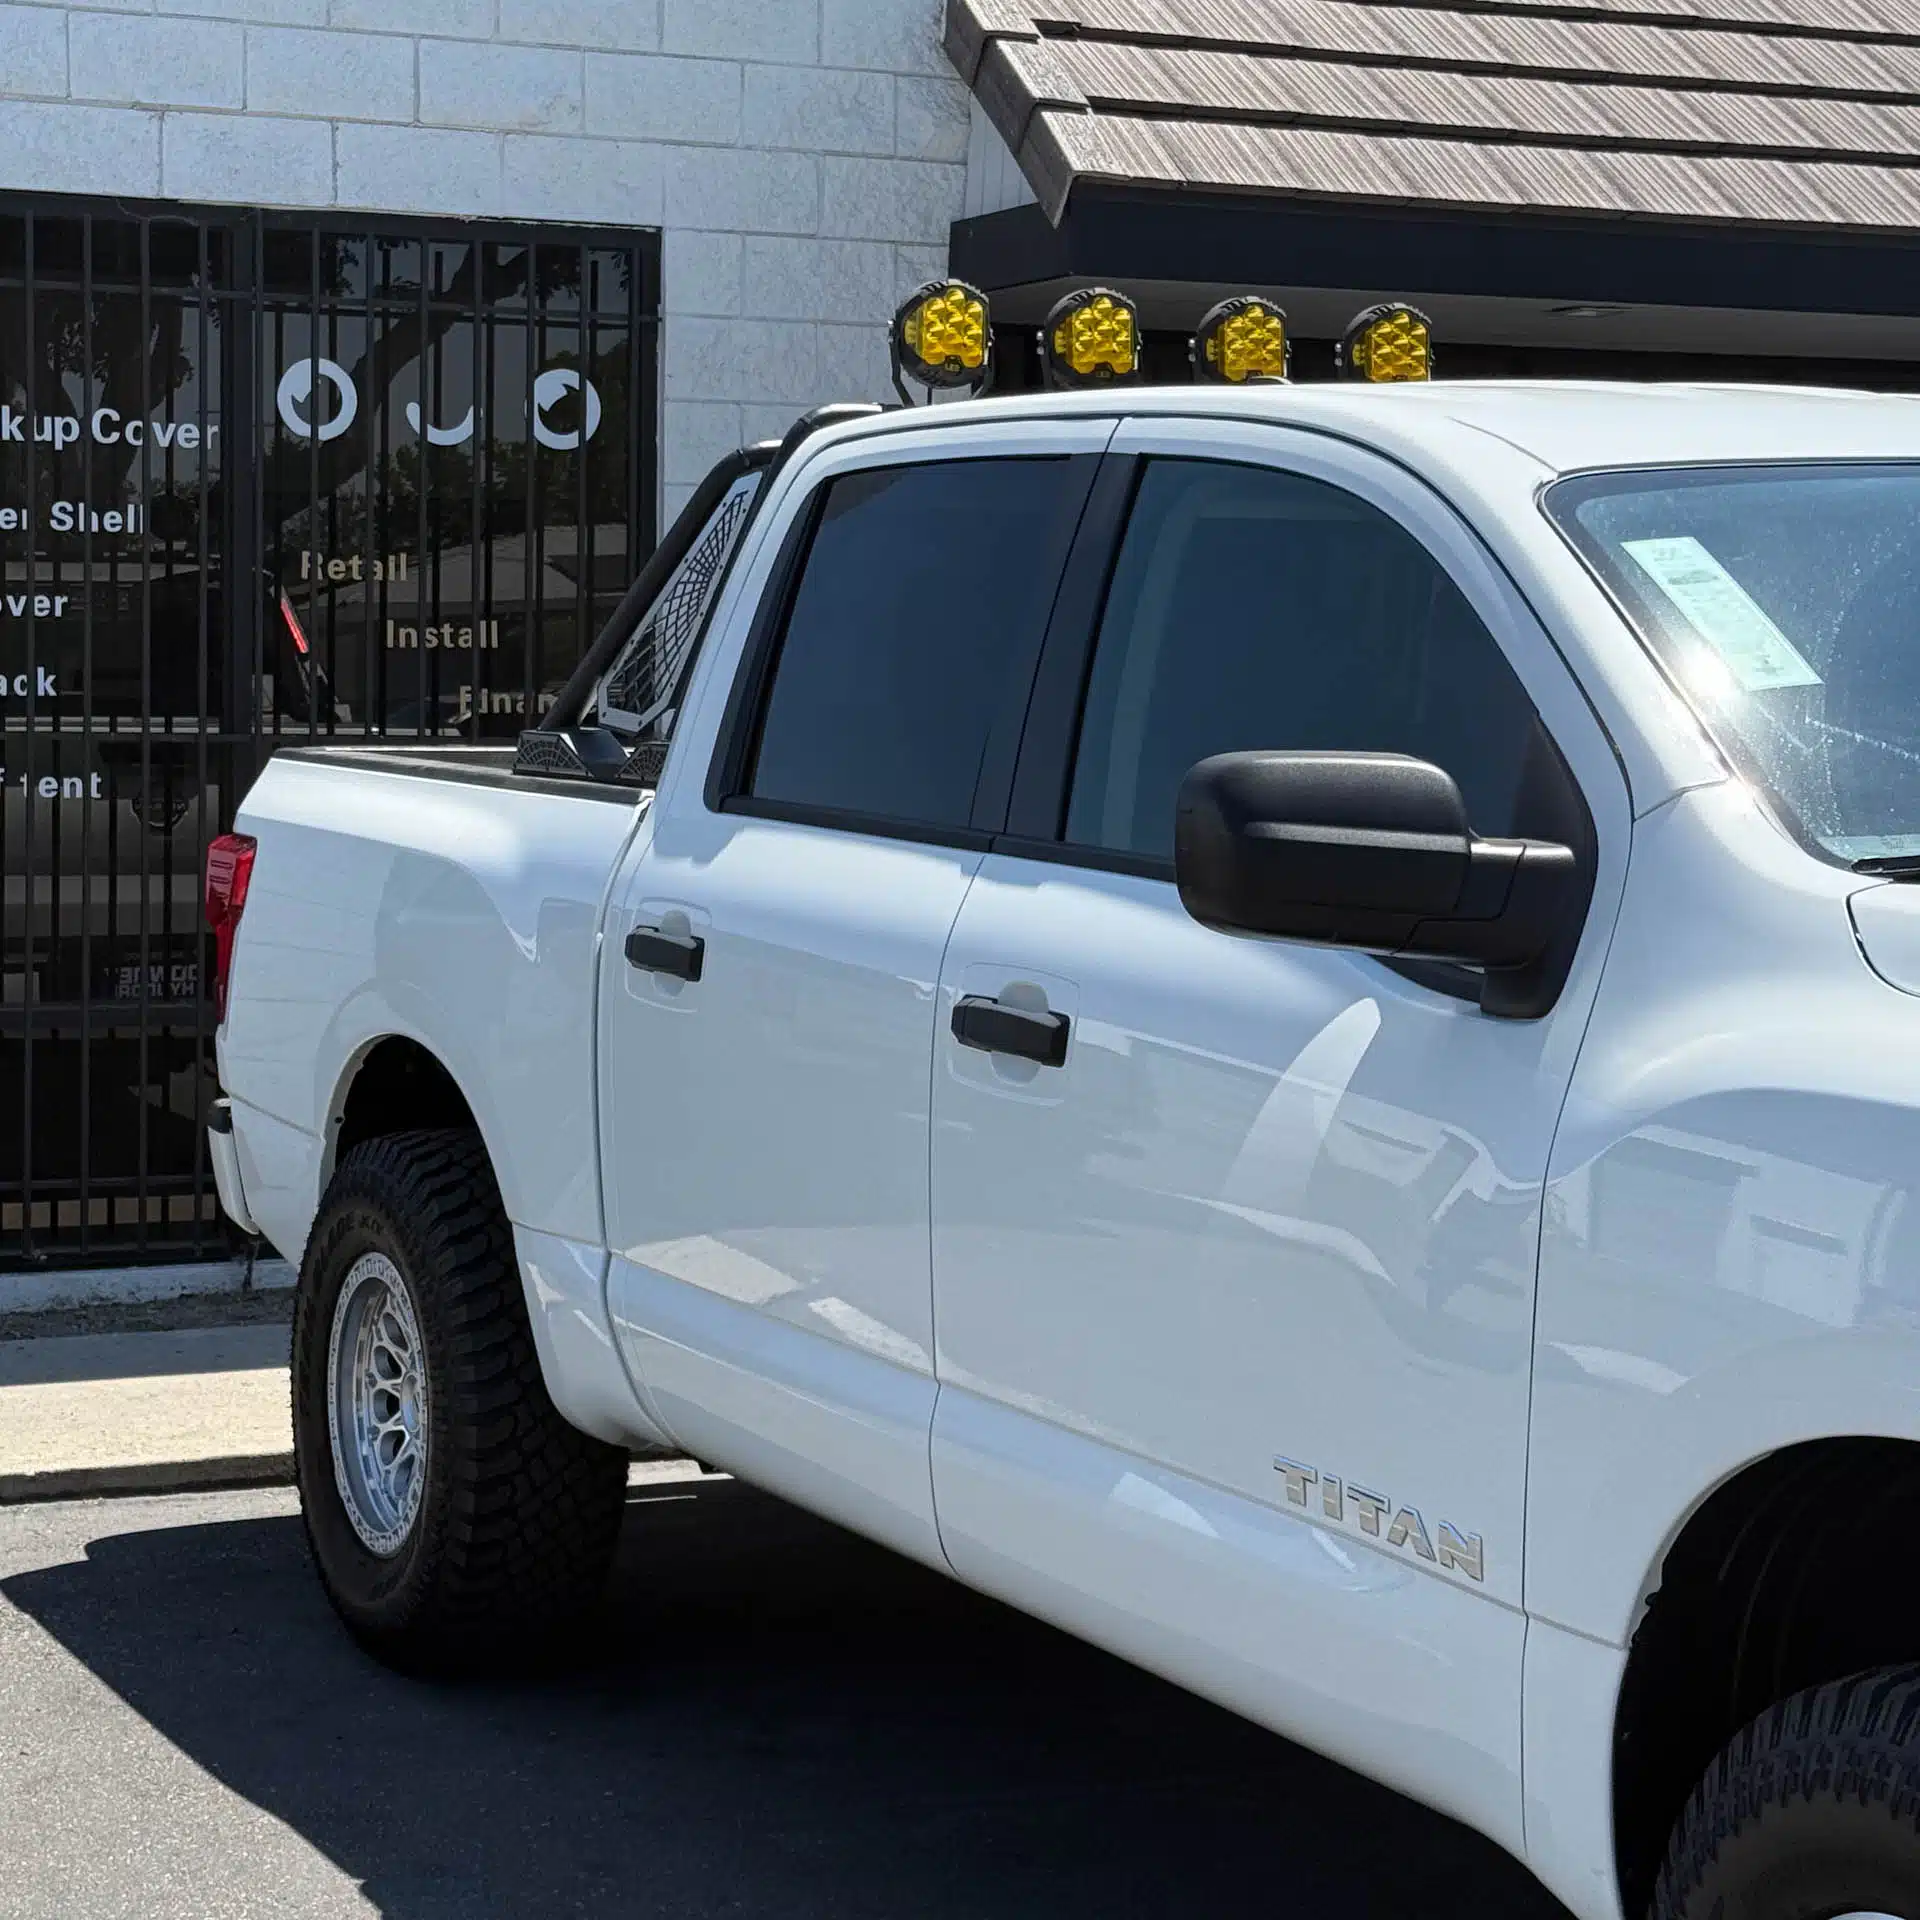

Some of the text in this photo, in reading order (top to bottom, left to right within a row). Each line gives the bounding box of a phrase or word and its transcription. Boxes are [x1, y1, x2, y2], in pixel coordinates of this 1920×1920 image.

[1, 405, 220, 450] kup Cover
[49, 501, 144, 535] Shell
[301, 550, 408, 581] Retail
[0, 593, 69, 618] ver
[385, 619, 499, 649] Install
[1272, 1454, 1484, 1583] TITAN
